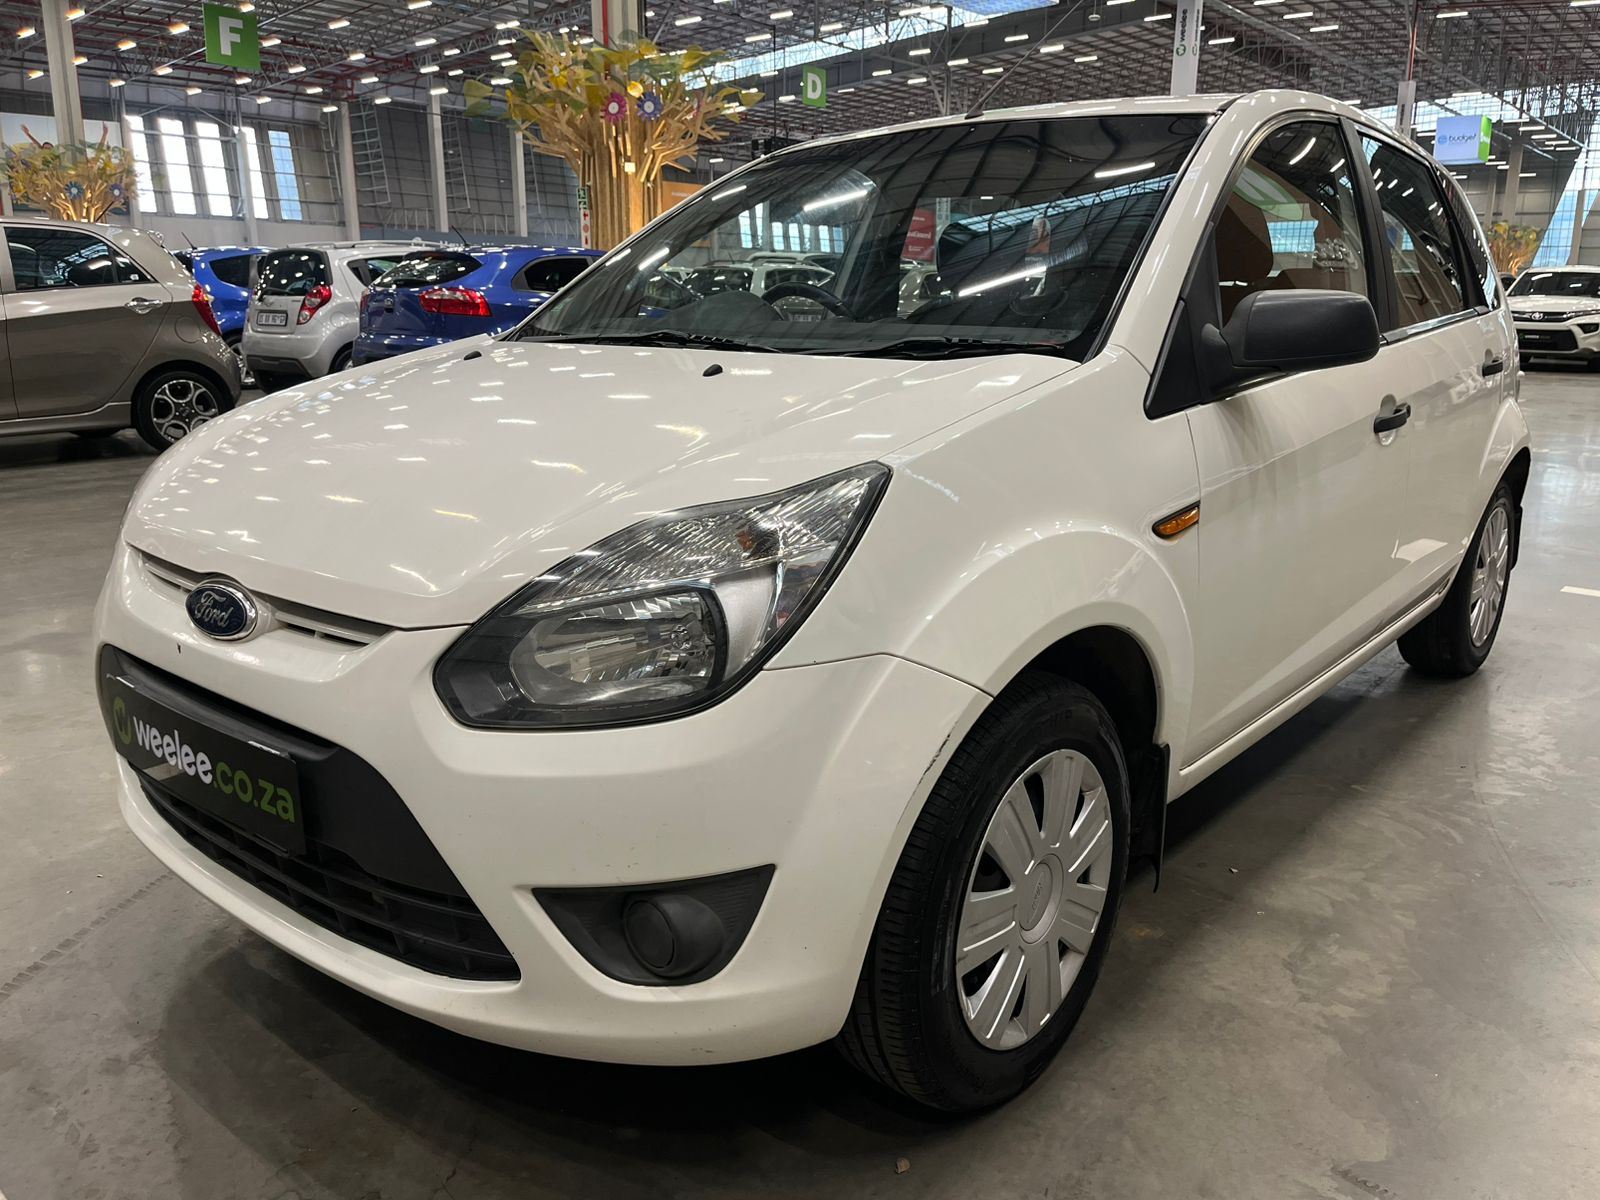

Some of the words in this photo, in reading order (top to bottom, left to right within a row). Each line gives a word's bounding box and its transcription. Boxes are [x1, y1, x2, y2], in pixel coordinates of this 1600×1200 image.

[219, 16, 243, 56] F
[807, 73, 821, 99] D
[1448, 133, 1477, 143] budget
[195, 591, 232, 626] Ford
[133, 716, 296, 824] weelee.co.za
